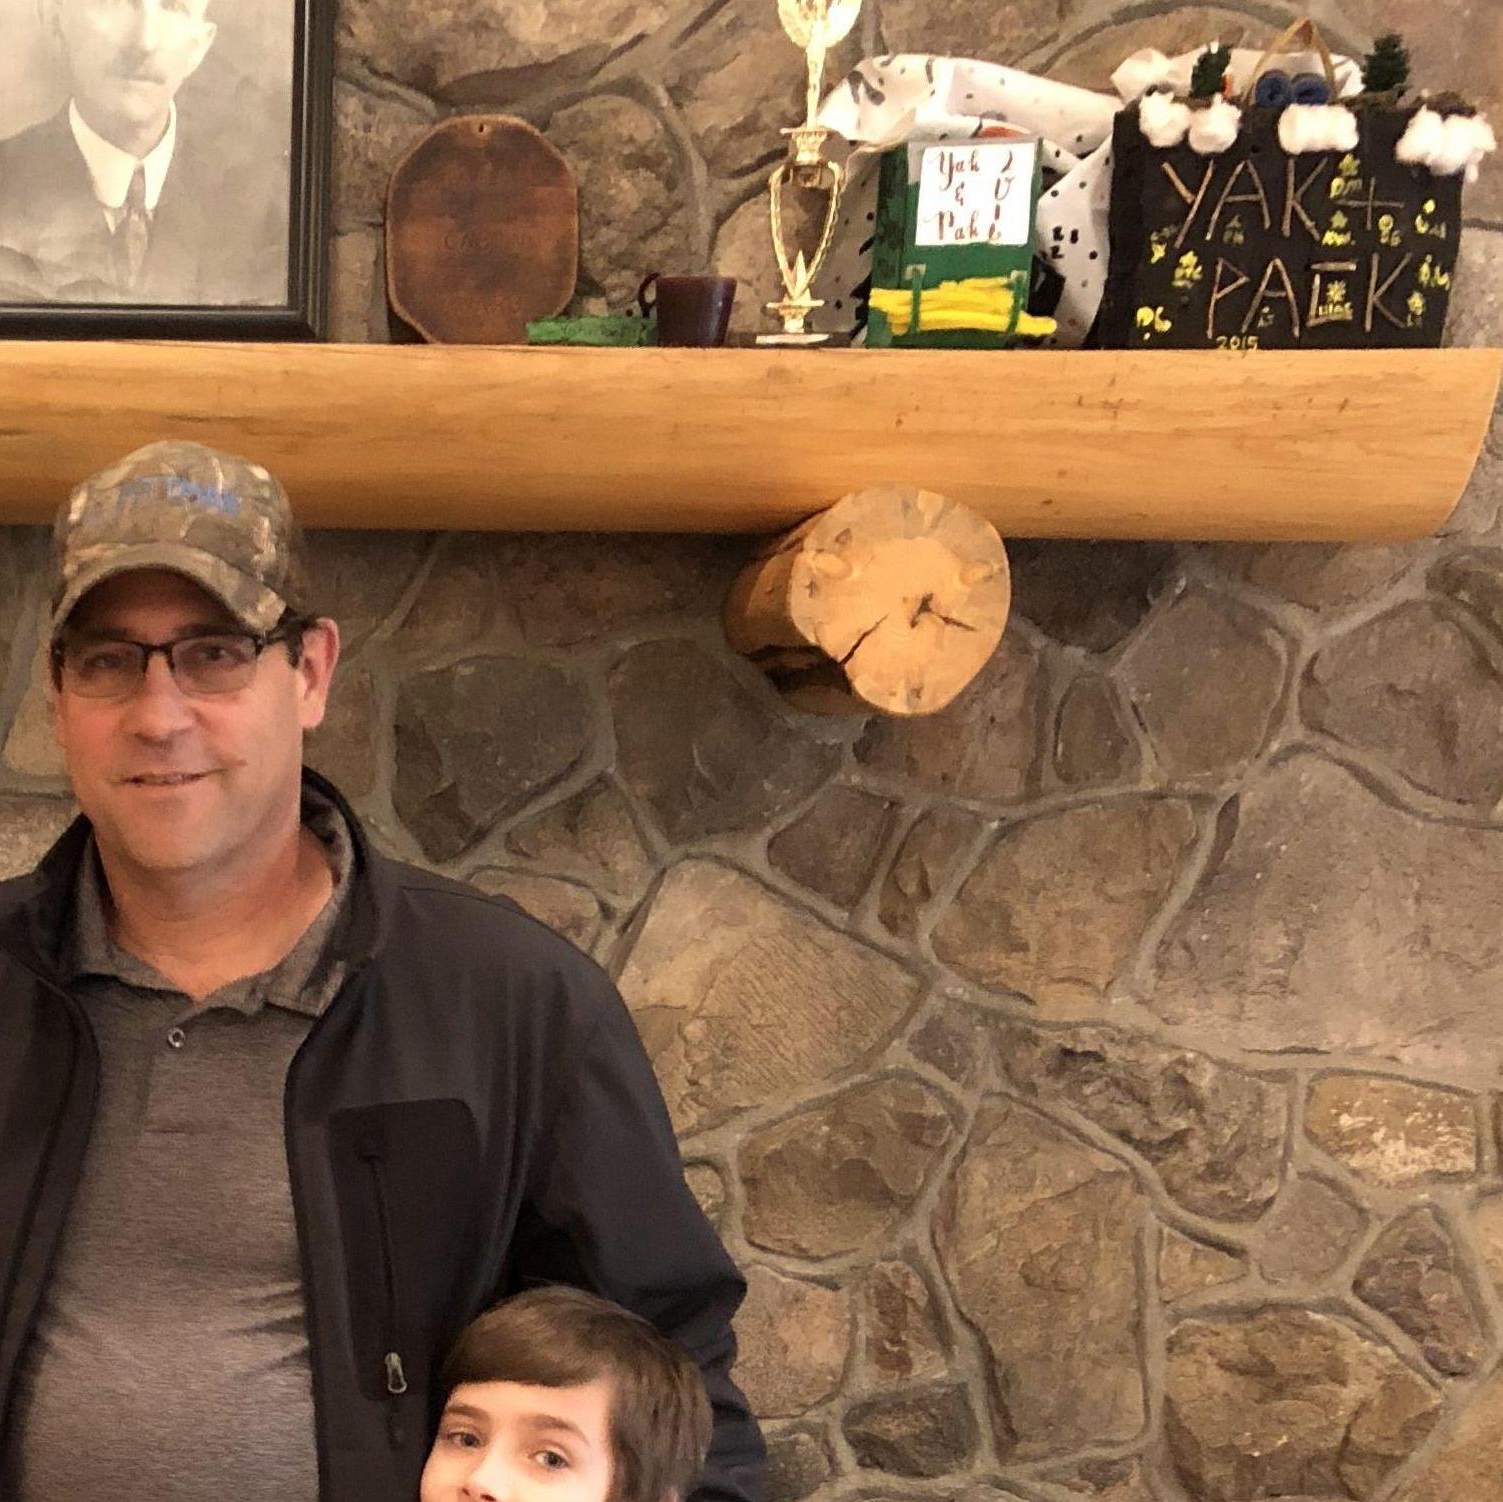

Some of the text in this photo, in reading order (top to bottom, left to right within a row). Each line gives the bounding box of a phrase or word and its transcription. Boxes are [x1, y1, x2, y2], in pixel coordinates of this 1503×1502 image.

[1161, 159, 1329, 250] YAK
[1206, 257, 1414, 340] PACK
[1215, 335, 1260, 354] 2015
